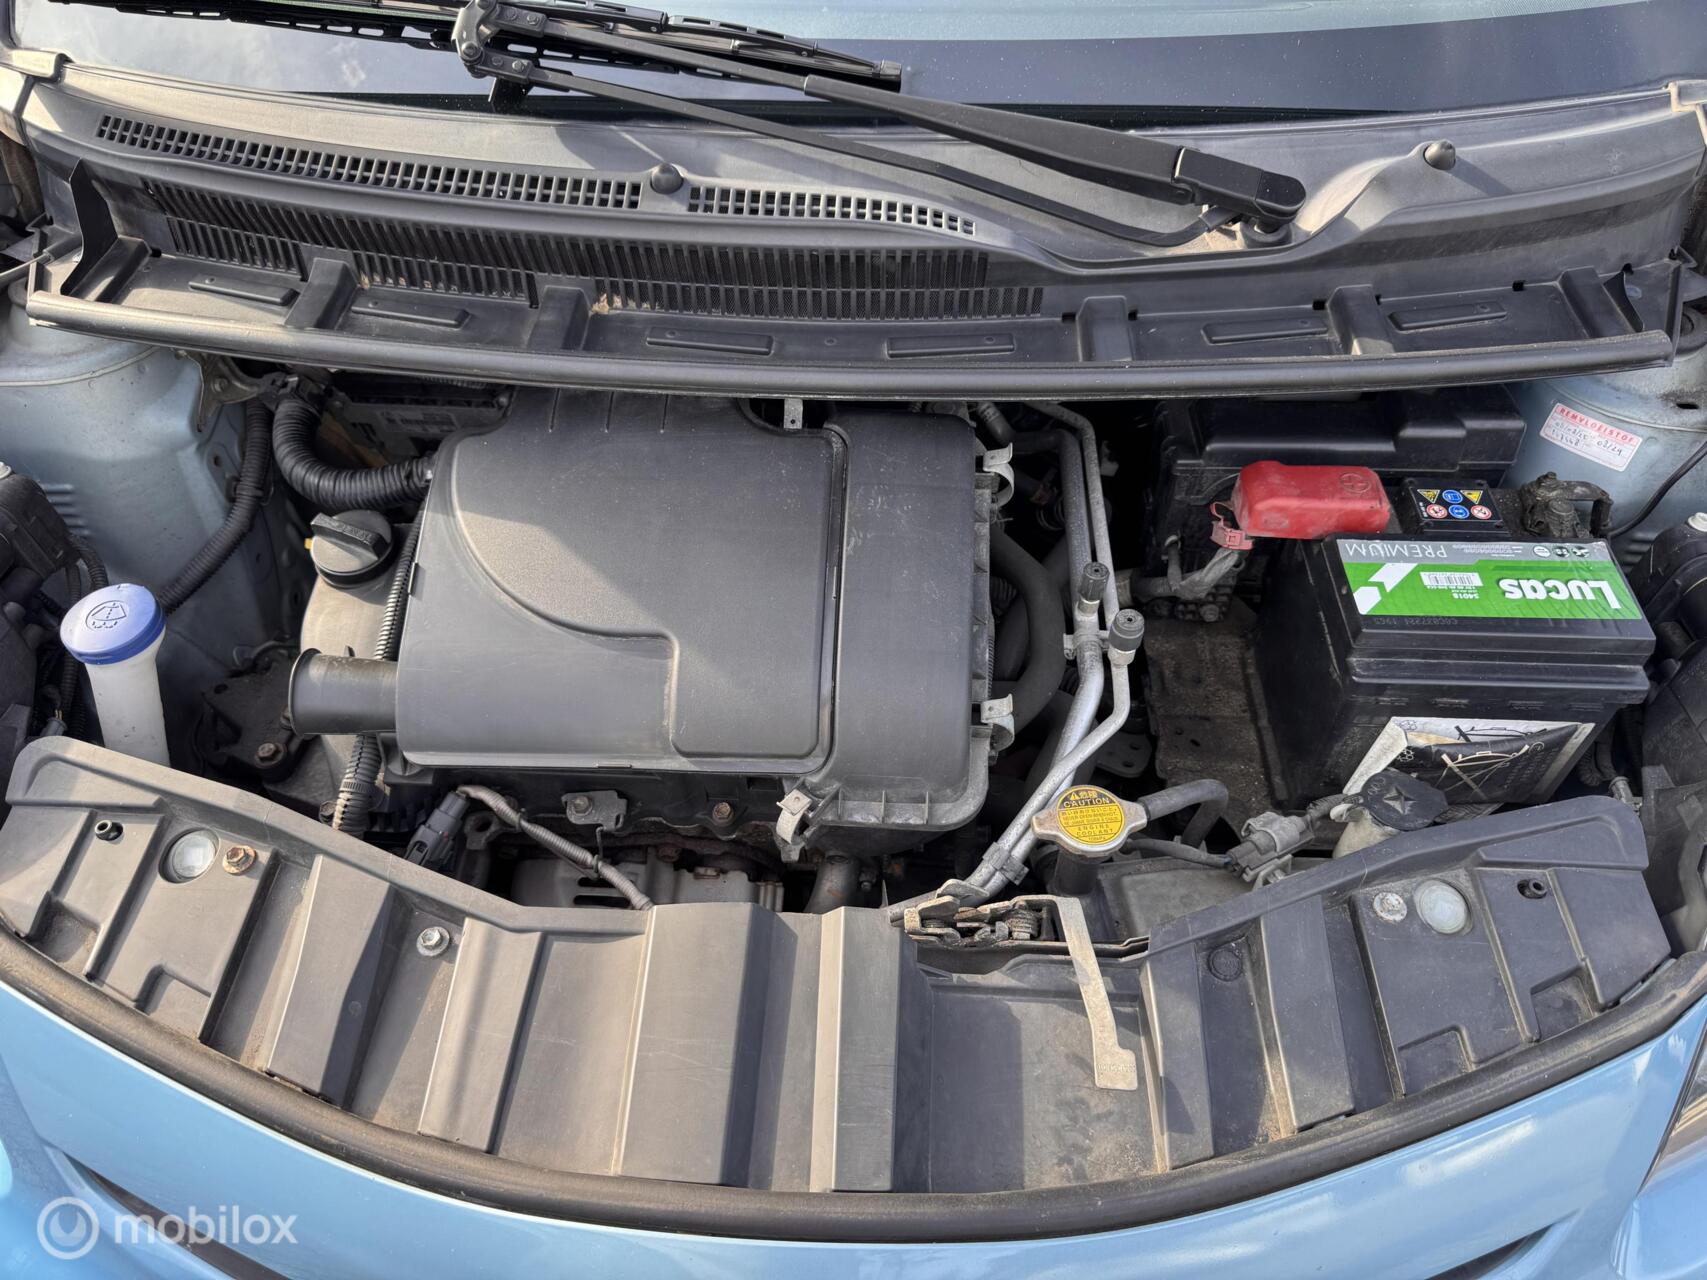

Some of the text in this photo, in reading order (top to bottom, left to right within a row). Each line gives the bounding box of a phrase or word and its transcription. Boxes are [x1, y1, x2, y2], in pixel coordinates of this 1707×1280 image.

[1345, 543, 1448, 558] PREMIUM
[1498, 578, 1622, 609] Lucas
[1063, 797, 1110, 808] CAUTION
[1076, 828, 1113, 836] COOLANT
